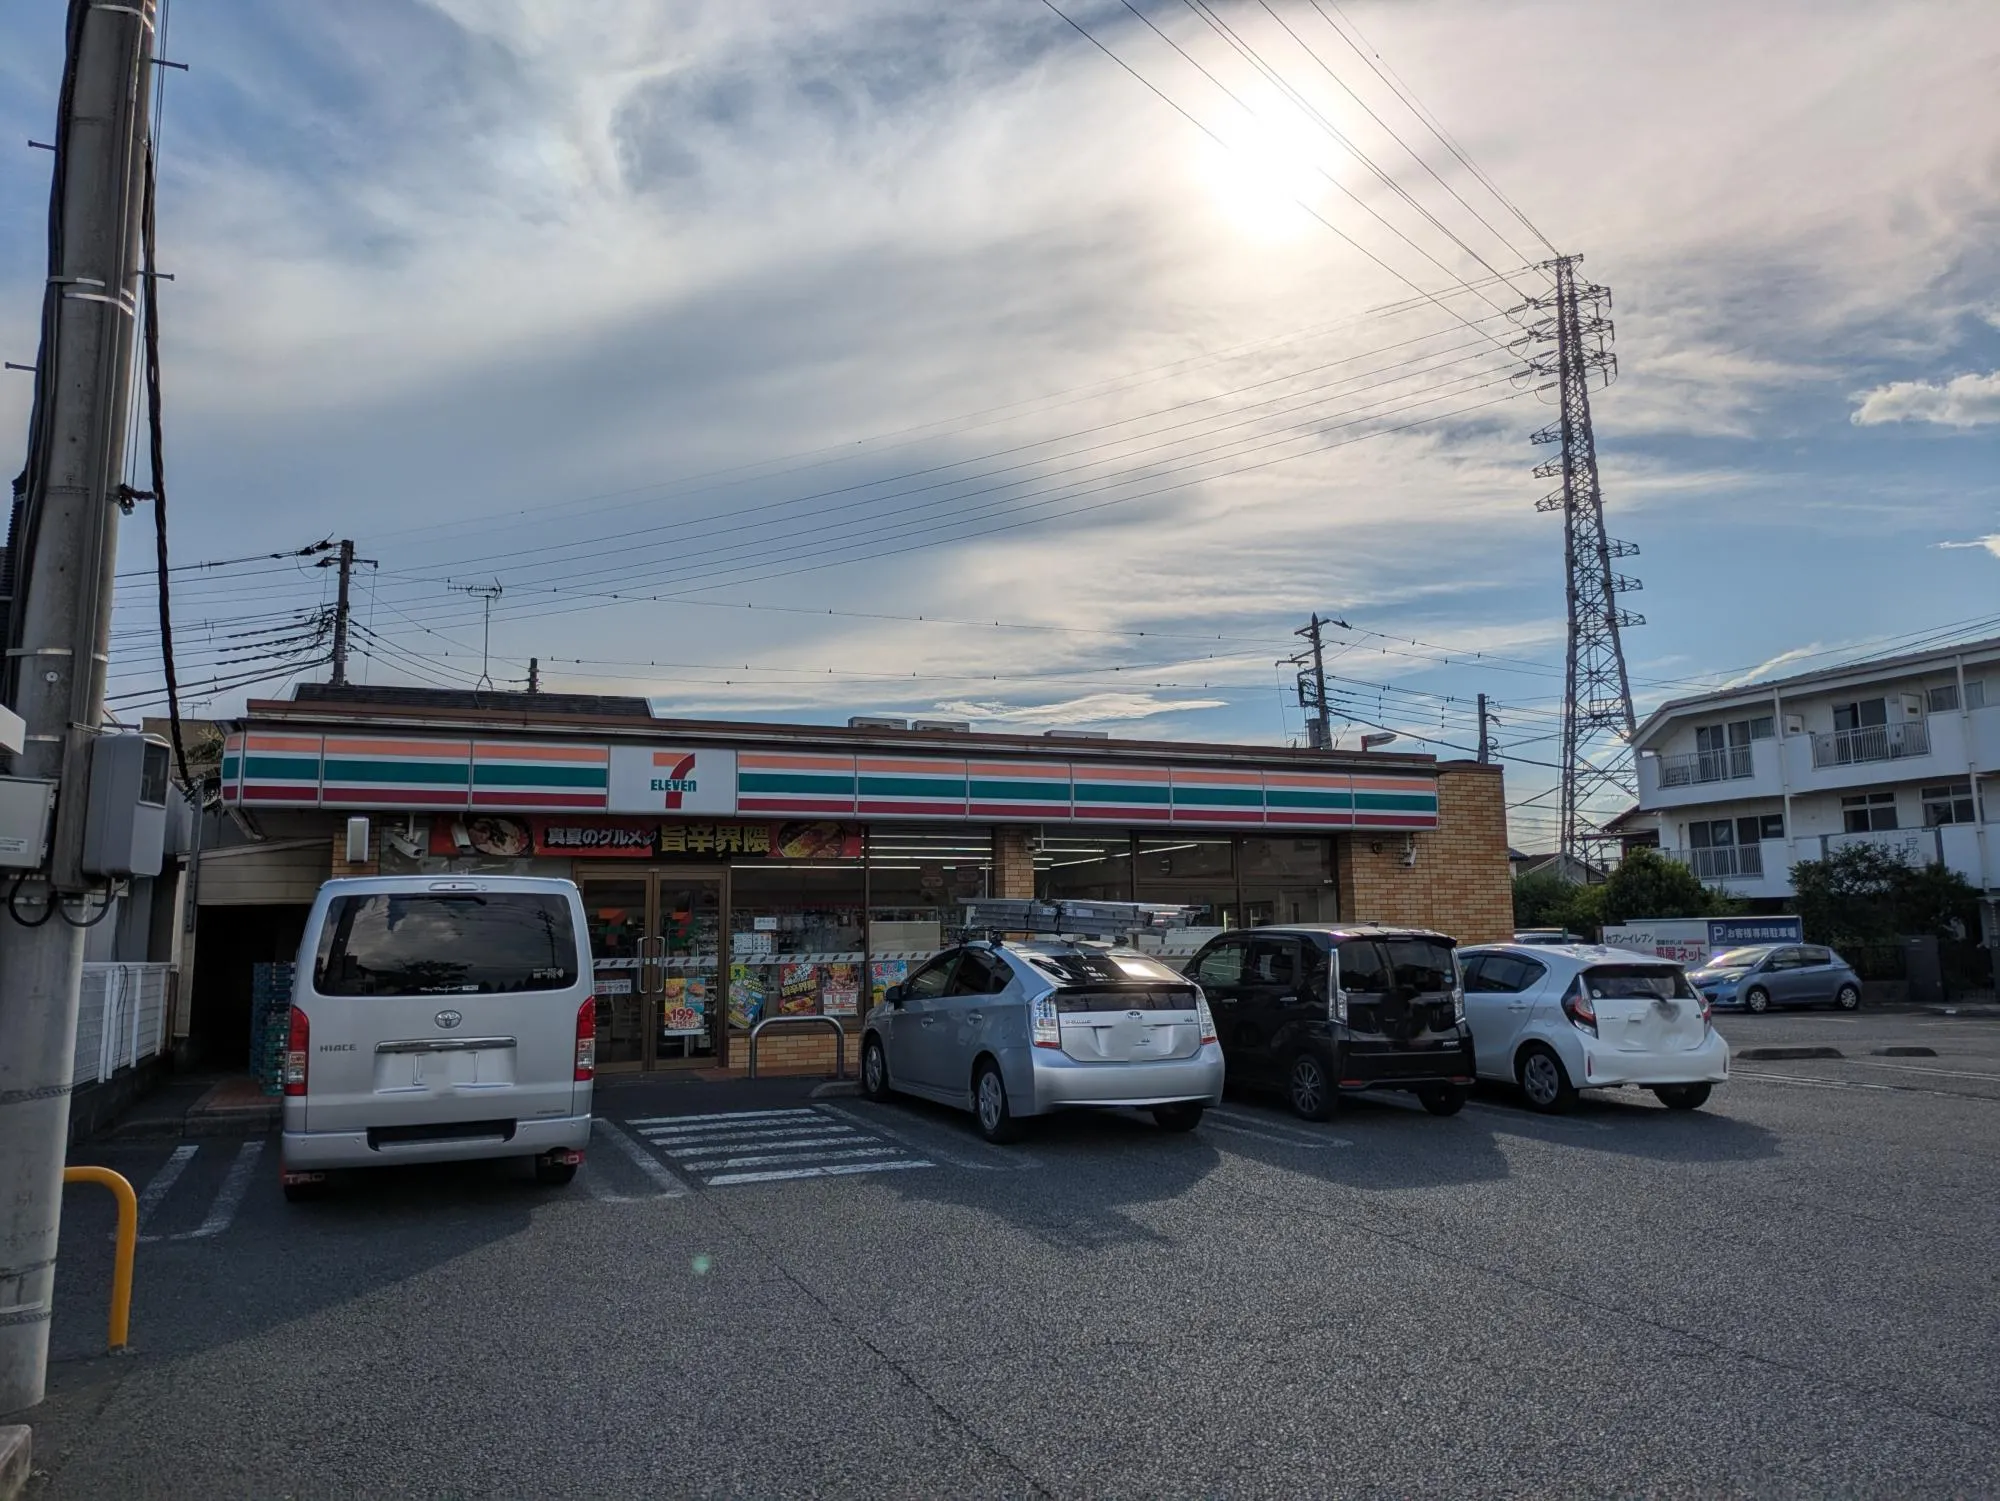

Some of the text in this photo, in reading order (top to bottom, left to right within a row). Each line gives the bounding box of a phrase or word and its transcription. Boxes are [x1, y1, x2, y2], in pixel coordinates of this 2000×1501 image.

[653, 752, 695, 808] 7
[660, 824, 772, 853] 旨辛界隈
[1713, 926, 1724, 941] P
[1727, 927, 1797, 939] お客様専用駐車場
[319, 1043, 357, 1053] HIACE
[284, 1172, 326, 1185] TRD
